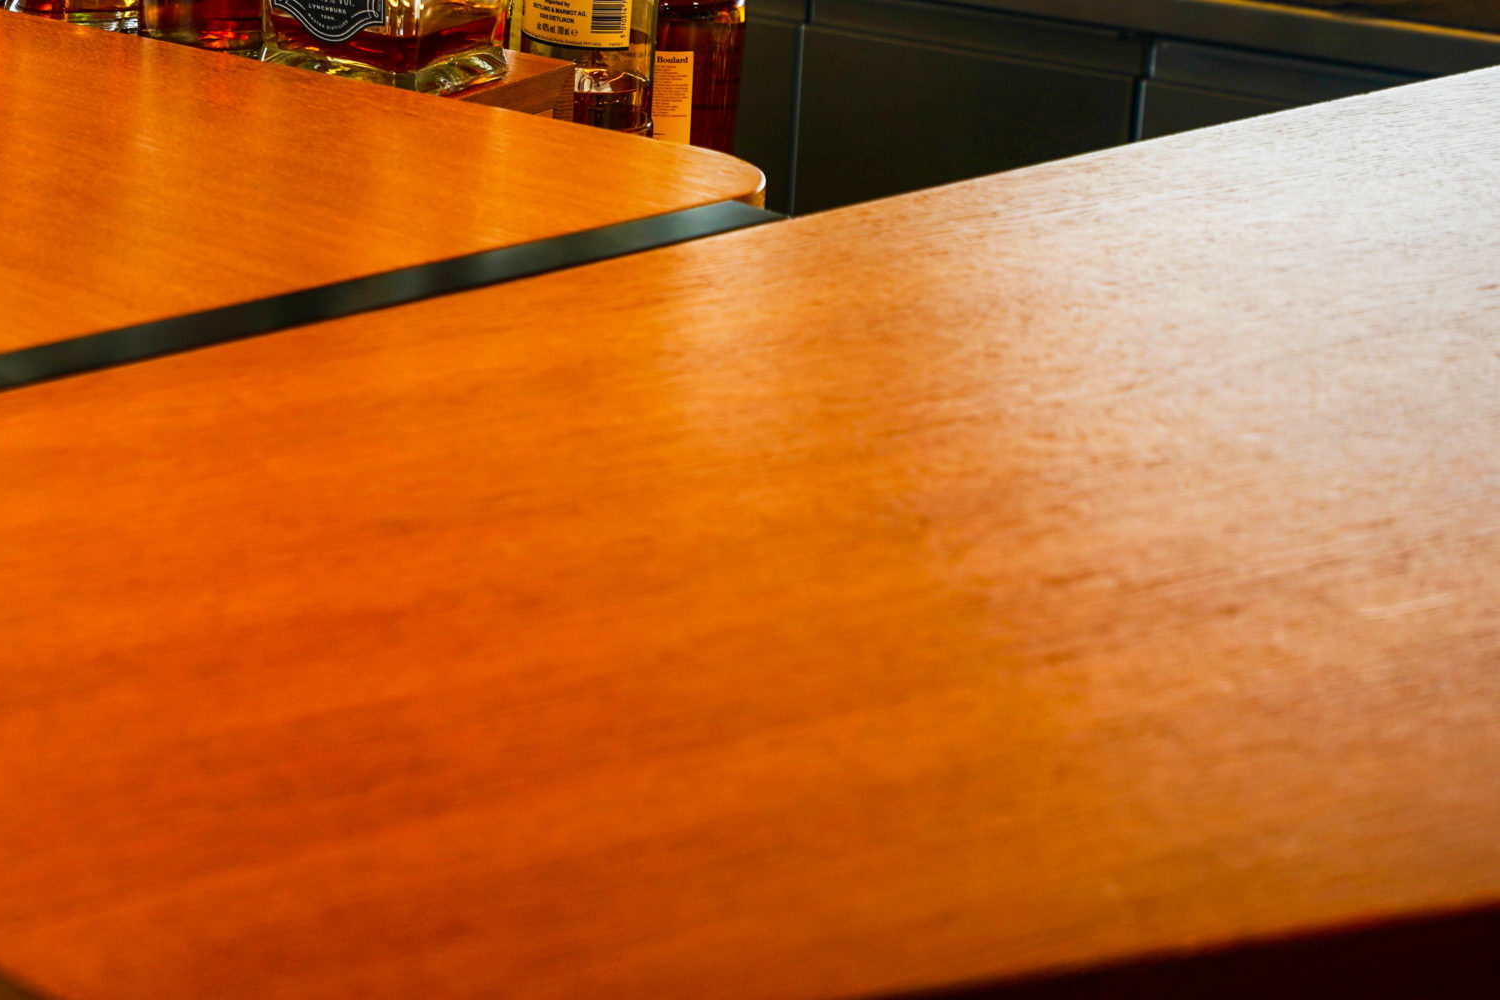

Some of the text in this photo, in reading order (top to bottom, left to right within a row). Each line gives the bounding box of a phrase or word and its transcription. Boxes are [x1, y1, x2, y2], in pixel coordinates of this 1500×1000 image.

[308, 3, 347, 15] LYNCHBURG
[308, 13, 325, 28] MASTER
[657, 56, 689, 64] Boulard
